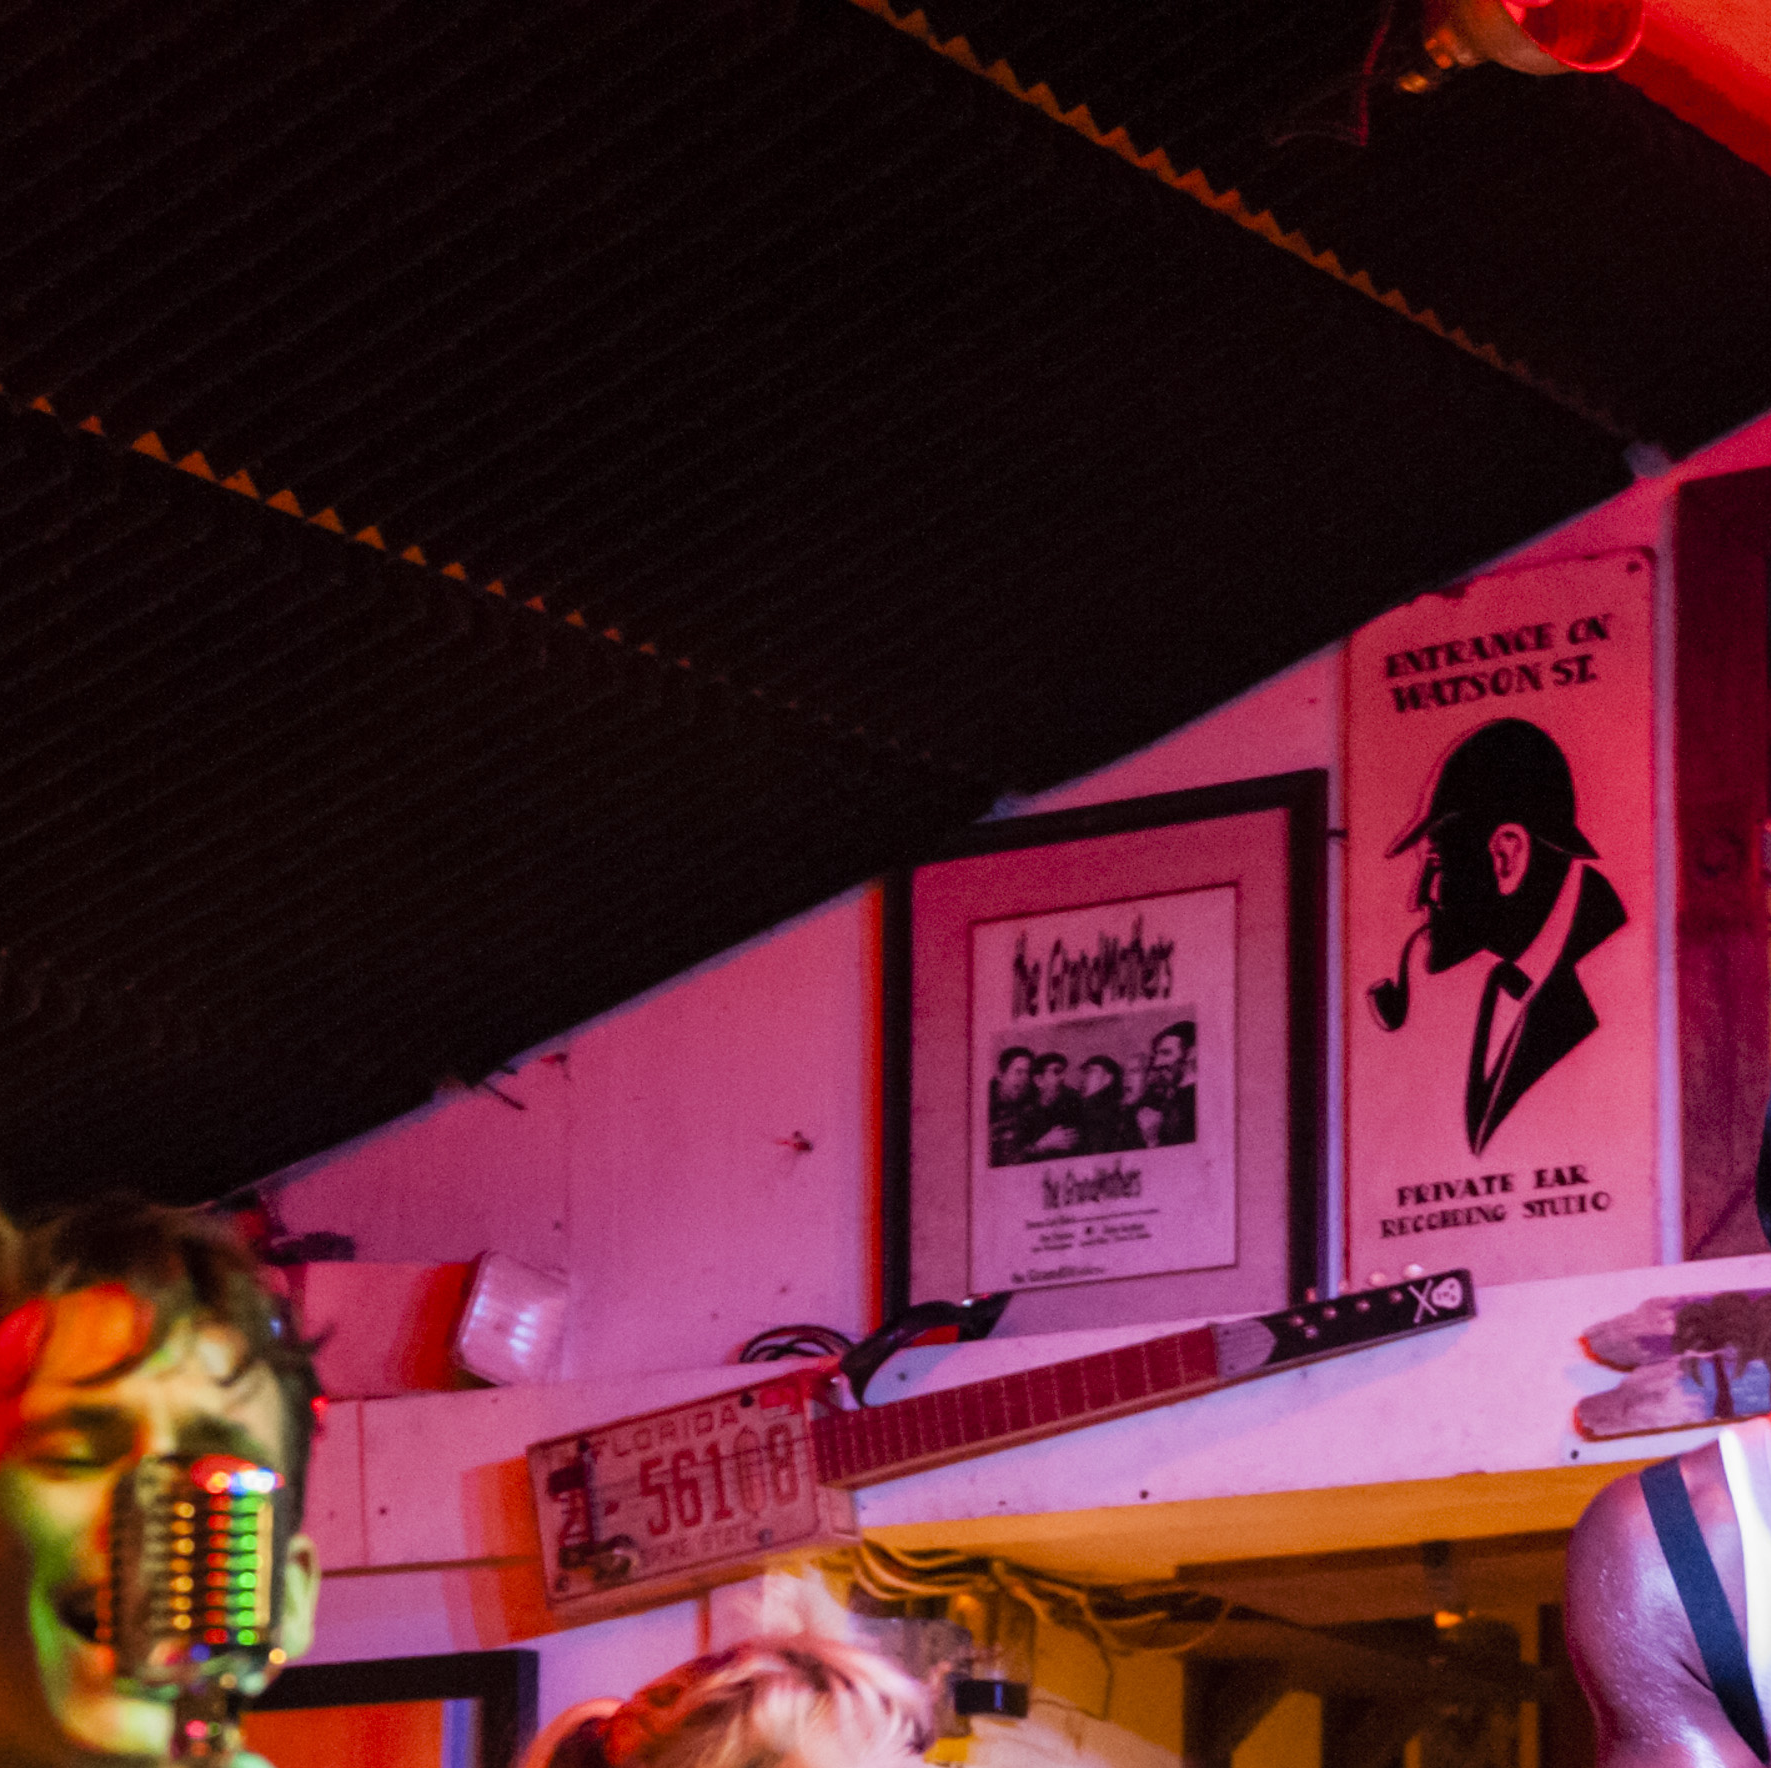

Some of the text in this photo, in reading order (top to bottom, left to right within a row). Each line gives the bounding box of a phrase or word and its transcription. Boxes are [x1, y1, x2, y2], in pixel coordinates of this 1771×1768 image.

[1385, 612, 1613, 679] ENTRANCE ON
[1392, 662, 1543, 713] WATSON
[1012, 930, 1040, 1021] the
[1396, 1163, 1590, 1208] PRIVATE EAR
[1380, 1190, 1613, 1239] RECORDING STUDIO
[588, 1403, 740, 1458] FLORIDA
